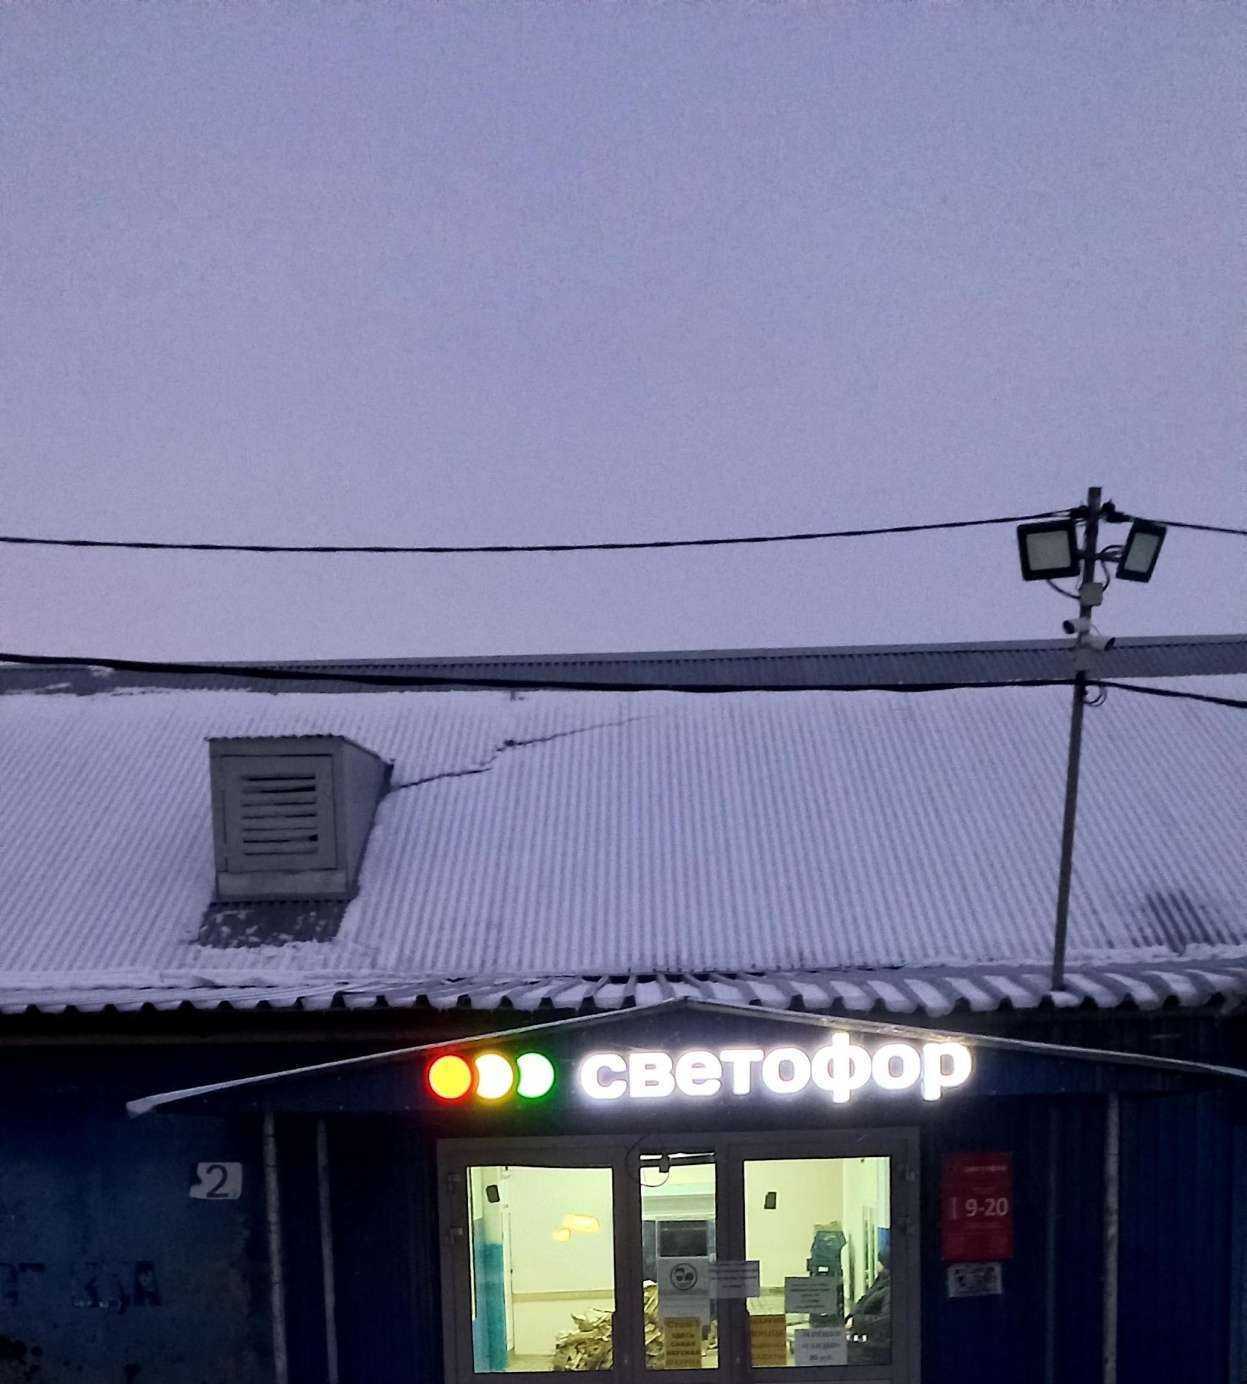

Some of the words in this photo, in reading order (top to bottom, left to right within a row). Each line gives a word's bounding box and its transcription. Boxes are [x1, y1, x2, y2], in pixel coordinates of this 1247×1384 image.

[579, 1032, 973, 1102] светофор
[206, 1164, 228, 1198] 2
[964, 1197, 1009, 1218] 9-20
